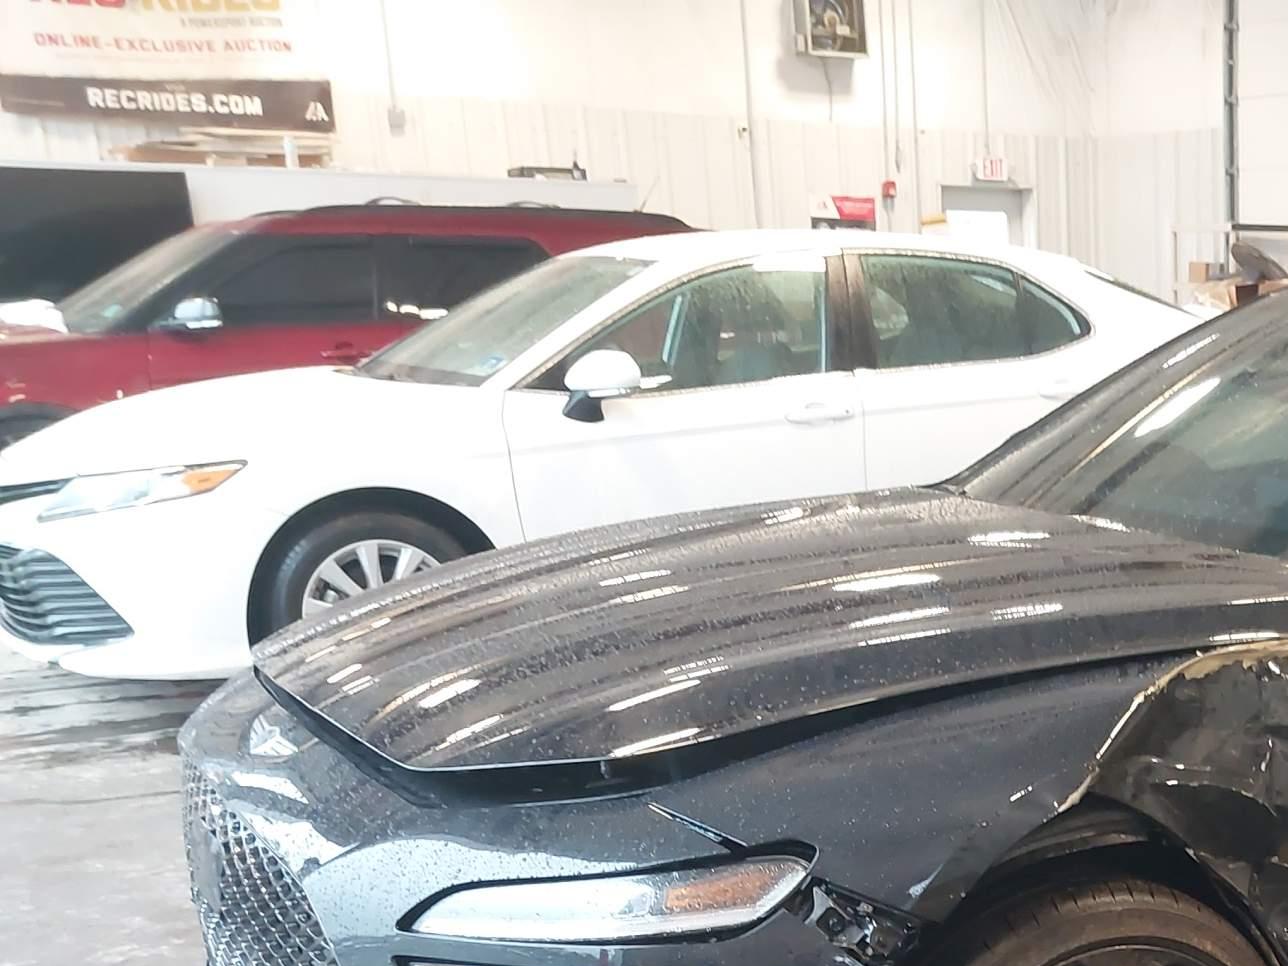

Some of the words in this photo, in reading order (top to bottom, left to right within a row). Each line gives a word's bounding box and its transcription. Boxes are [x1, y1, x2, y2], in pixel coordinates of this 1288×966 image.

[33, 32, 216, 54] ONLINE-EXCLUSIVE
[224, 39, 293, 53] AUCTION
[85, 86, 263, 116] RECRIDES.COM
[983, 159, 1003, 178] EXIT
